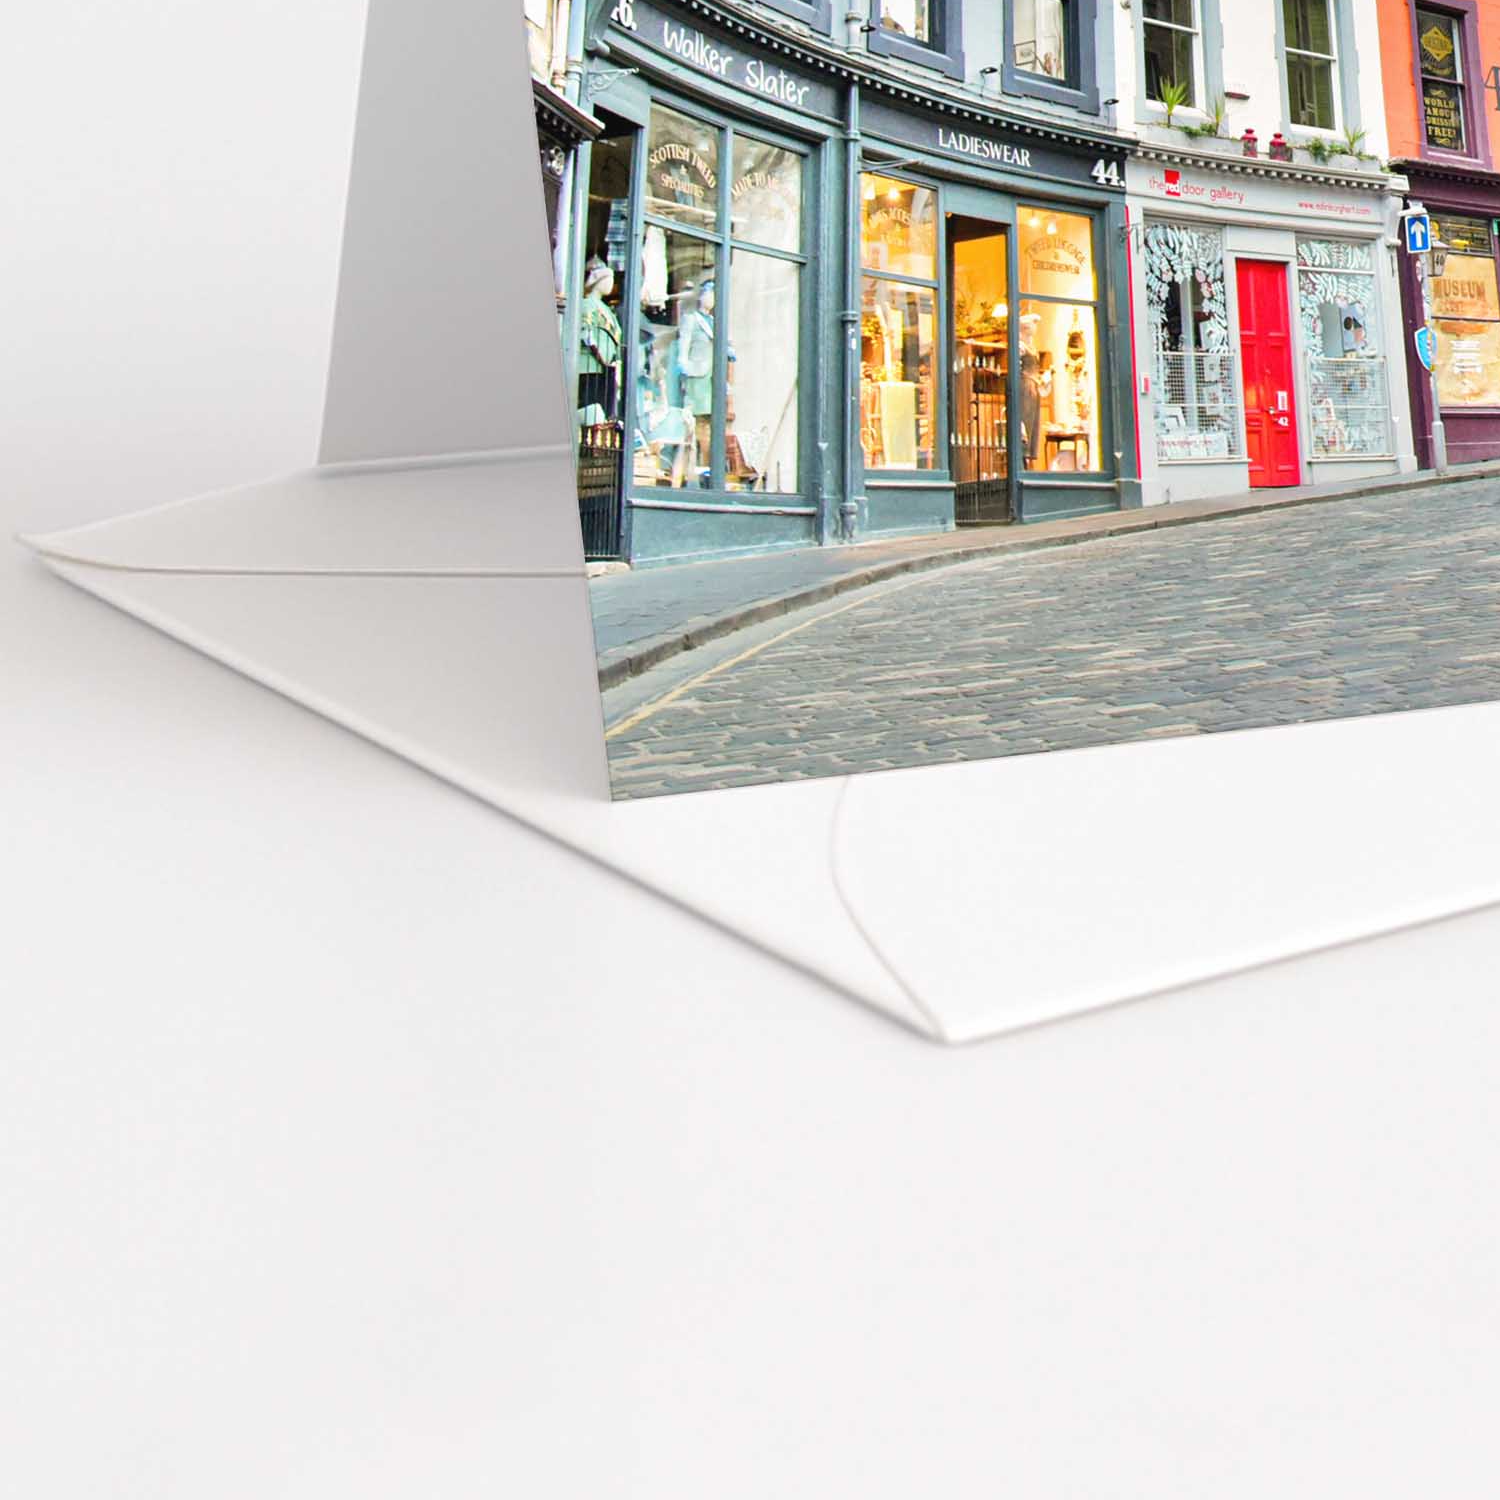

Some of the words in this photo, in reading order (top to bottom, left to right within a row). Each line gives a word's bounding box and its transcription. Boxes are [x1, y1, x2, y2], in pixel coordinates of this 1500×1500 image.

[663, 21, 733, 76] Walker
[745, 60, 810, 105] Slater
[649, 143, 691, 168] SCOTTISH
[938, 128, 1031, 167] LADIESWEAR
[1181, 180, 1205, 196] door
[1209, 185, 1245, 204] gallery
